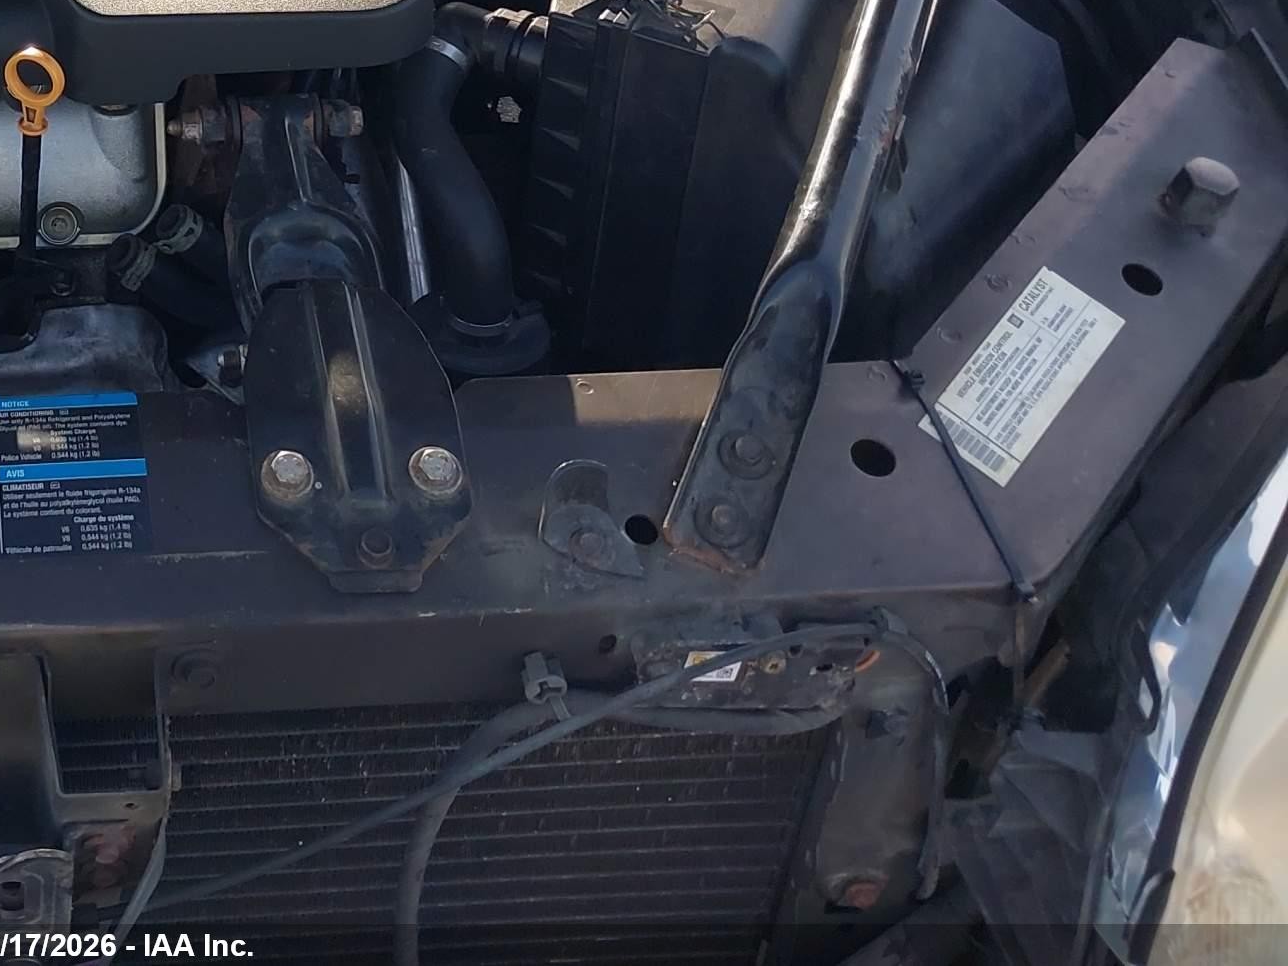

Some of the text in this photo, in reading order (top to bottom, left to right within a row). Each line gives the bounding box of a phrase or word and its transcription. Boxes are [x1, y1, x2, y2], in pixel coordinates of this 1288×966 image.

[1018, 278, 1049, 312] CATALYST
[972, 351, 994, 377] EMISSION
[991, 329, 1012, 354] CONTROL
[977, 350, 1006, 385] INFORMATION
[2, 483, 44, 491] CLIMATISEUR
[6, 469, 25, 477] AVIS
